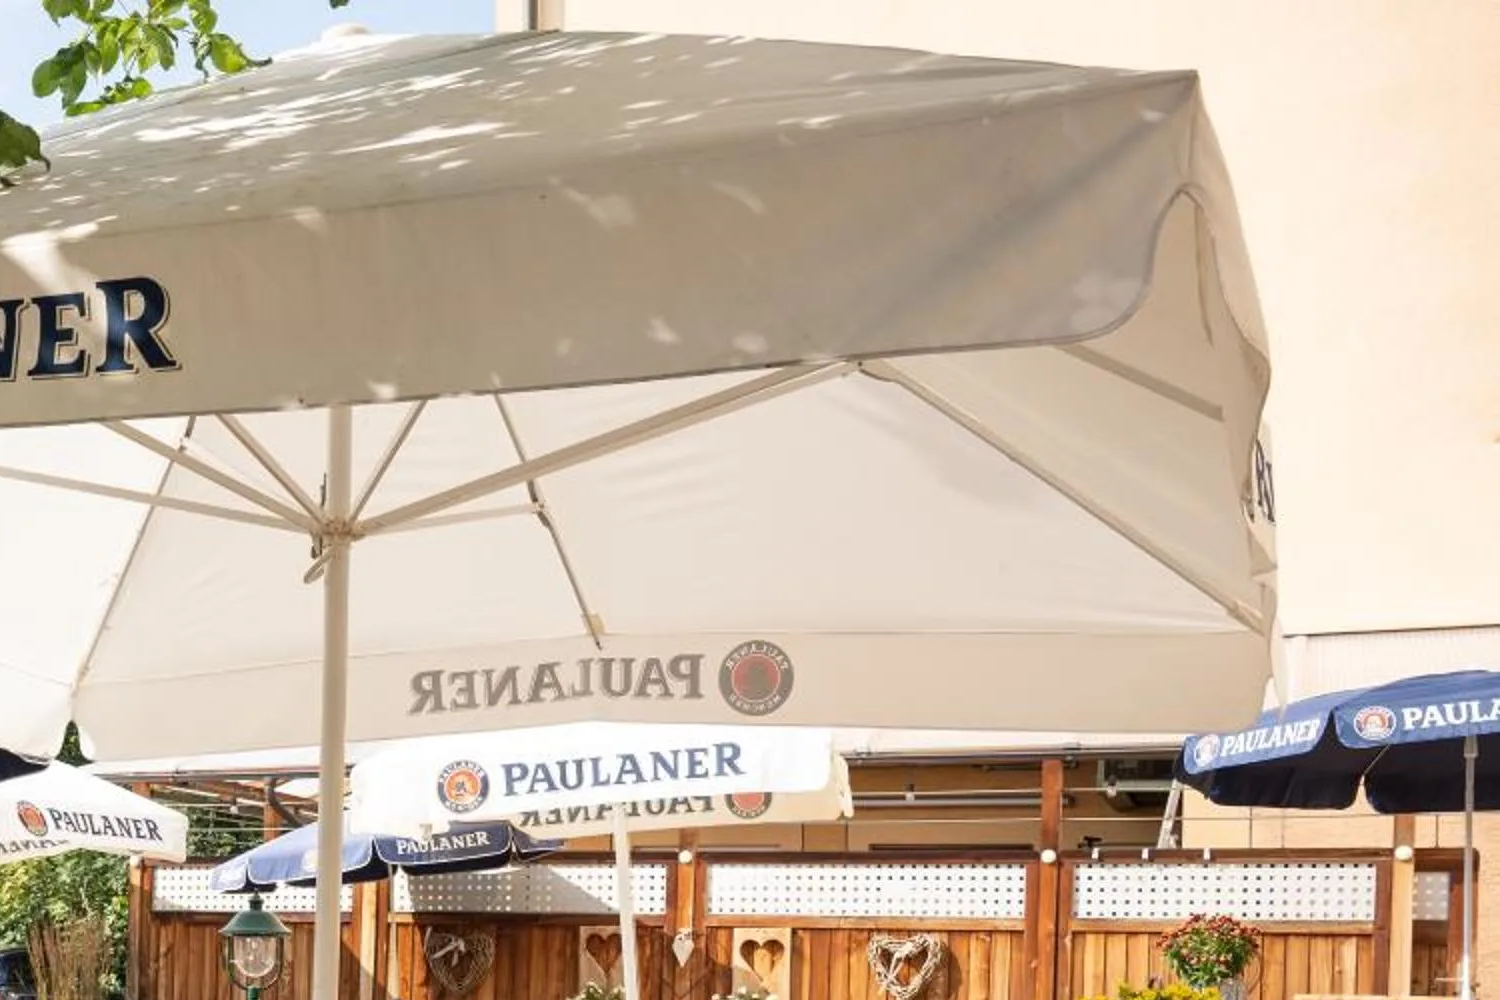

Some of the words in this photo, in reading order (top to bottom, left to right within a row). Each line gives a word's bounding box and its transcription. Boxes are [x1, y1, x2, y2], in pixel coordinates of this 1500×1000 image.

[500, 742, 747, 796] PAULANER
[47, 807, 163, 842] PAULANER
[395, 831, 491, 855] PAULANER
